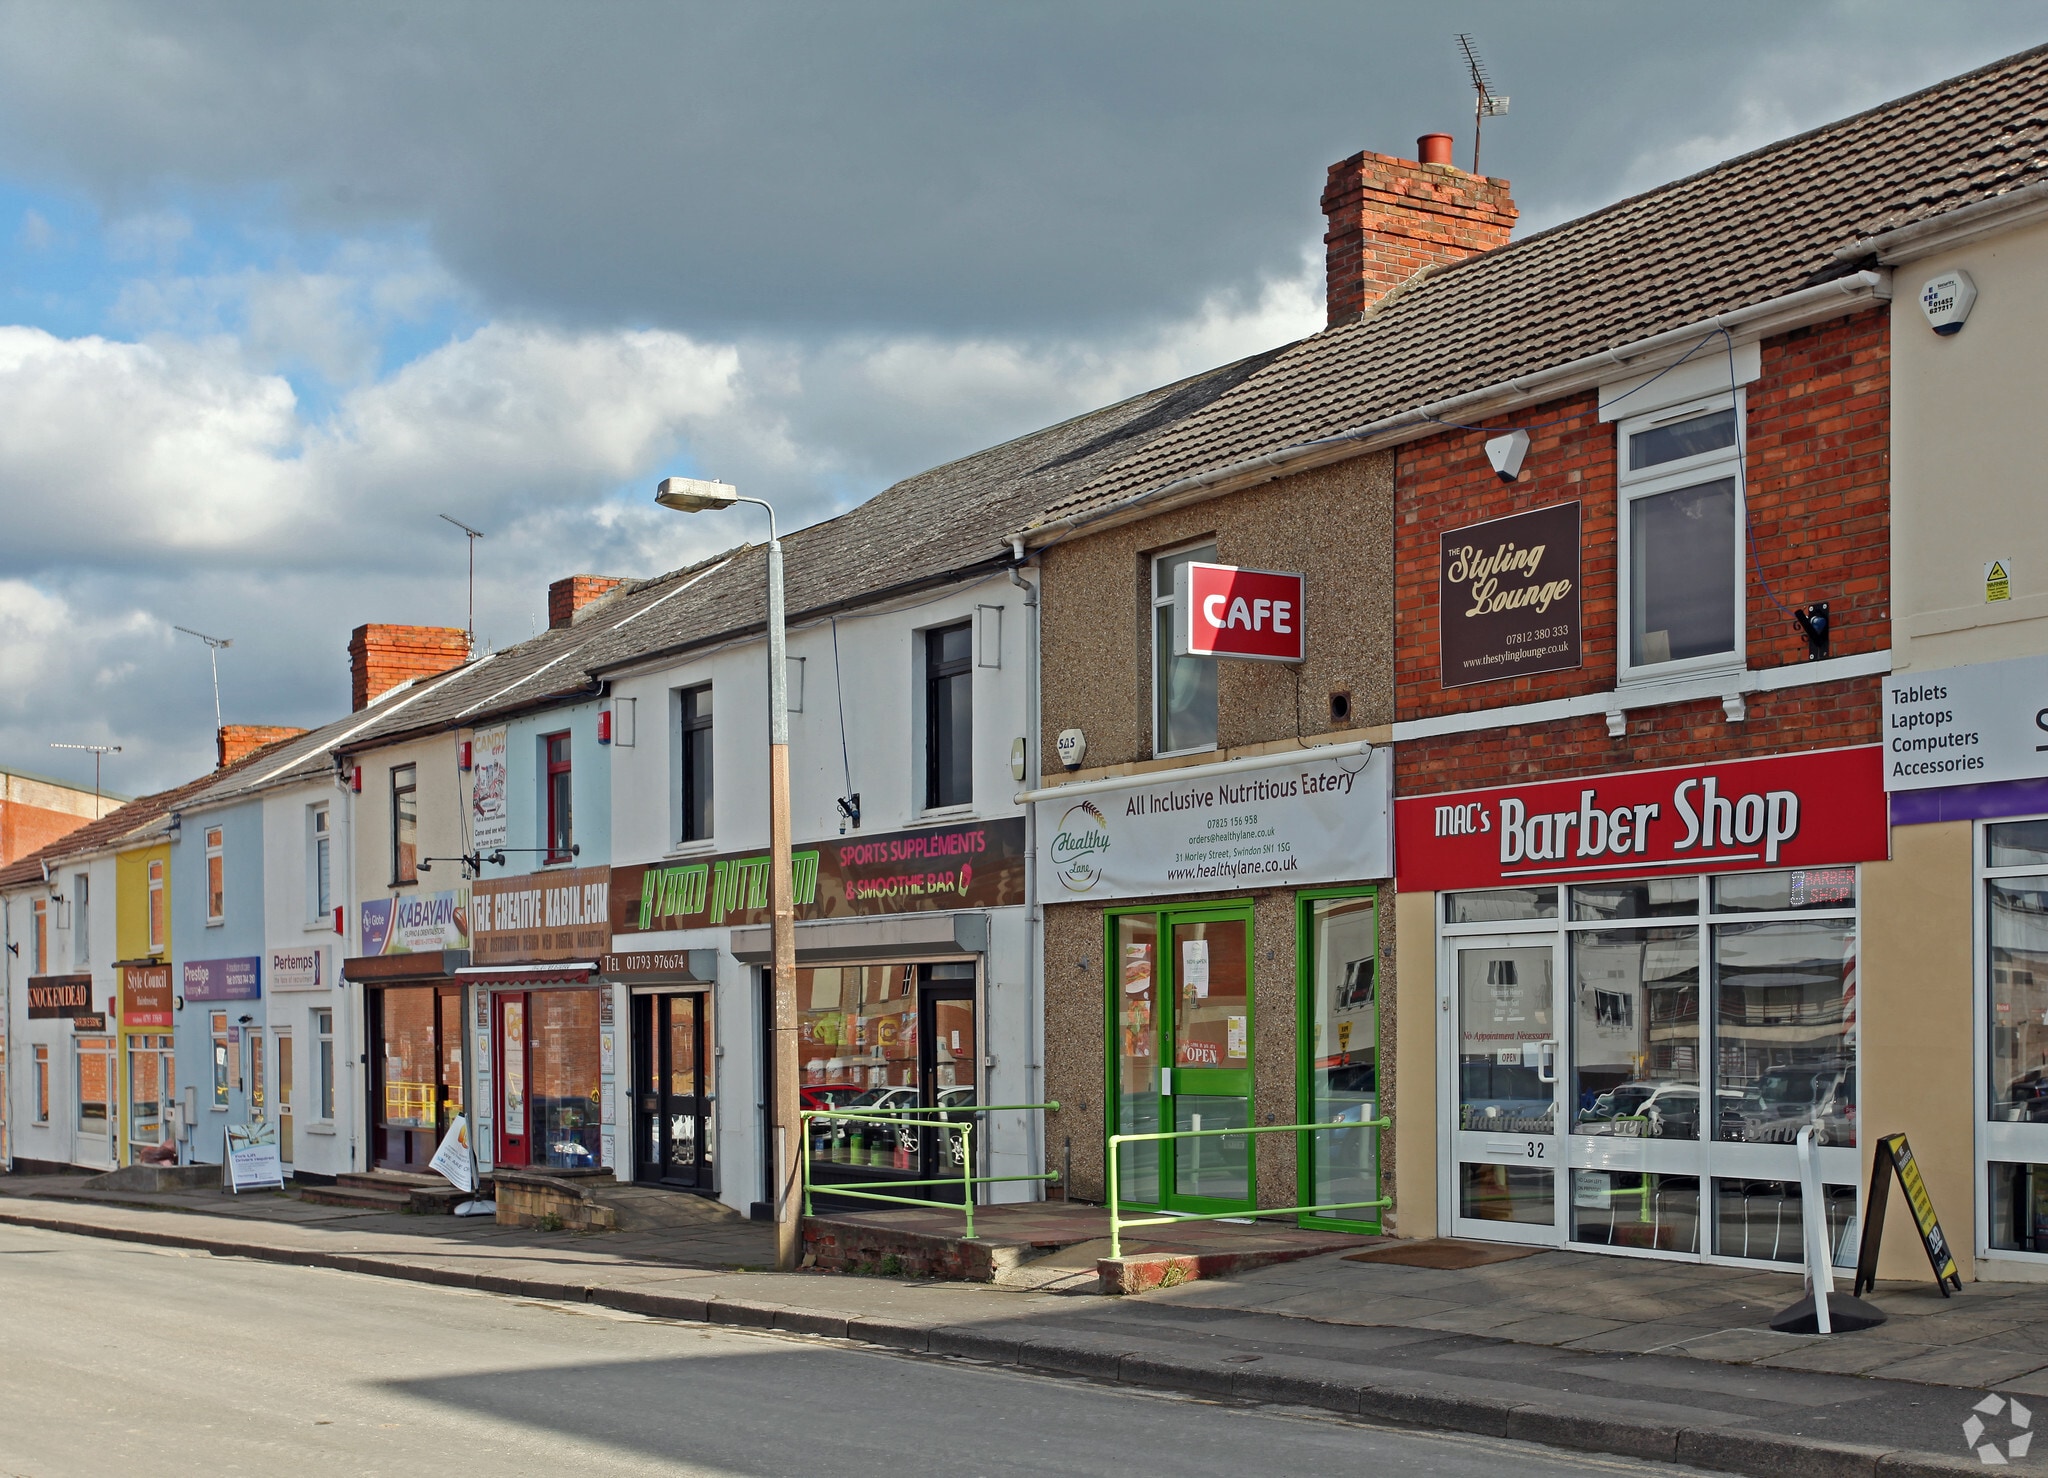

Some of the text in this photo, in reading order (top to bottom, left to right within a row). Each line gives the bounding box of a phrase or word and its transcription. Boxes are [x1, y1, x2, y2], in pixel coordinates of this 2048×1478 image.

[1448, 542, 1546, 587] THE Styling
[1465, 577, 1572, 618] Lounge
[1203, 594, 1291, 634] CAFE
[1506, 625, 1569, 645] 07812 380 333
[1463, 641, 1569, 668] www.thestylinglounge.co.uk
[1892, 685, 1947, 705] Tablets
[1891, 710, 1953, 730] Laptops
[475, 731, 506, 754] CANDY
[1892, 732, 1979, 753] Computers
[1893, 755, 1984, 777] Accessories
[1126, 772, 1356, 816] All Inclusive Nutritious Eatery
[1207, 814, 1258, 829] 07825 156 958
[1499, 789, 1659, 864] Barber
[1673, 776, 1800, 863] Shop
[1188, 827, 1275, 844] orders@healthylane.co.uk
[840, 830, 986, 867] SPORTS SUPPLEMENTS
[1051, 829, 1111, 864] Healthy
[1175, 842, 1291, 862] 31 Morley Street, Swindon SN1 1SG
[1069, 861, 1091, 874] Lane
[1167, 855, 1298, 880] www.healthylane.co.uk
[1805, 870, 1855, 885] BARBER
[638, 850, 819, 930] HYBRID NUTRION
[845, 871, 954, 900] & SMOOTHIE BAR
[1810, 887, 1848, 903] SHOP
[397, 898, 454, 929] KABAYAN
[473, 882, 608, 932] THE CREATIVE KABIN.COM
[371, 914, 384, 926] Globe
[274, 954, 313, 971] Pertemps
[605, 954, 684, 972] TEL 01793 976674
[127, 969, 167, 993] Style Council
[185, 965, 209, 985] Prestige
[1463, 1030, 1551, 1042] No Appointment Necessary
[1187, 1047, 1216, 1064] OPEN
[1502, 1053, 1516, 1062] OPEN
[1464, 1105, 1553, 1132] Traditional
[1610, 1113, 1664, 1136] Gents
[1527, 1141, 1545, 1158] 32
